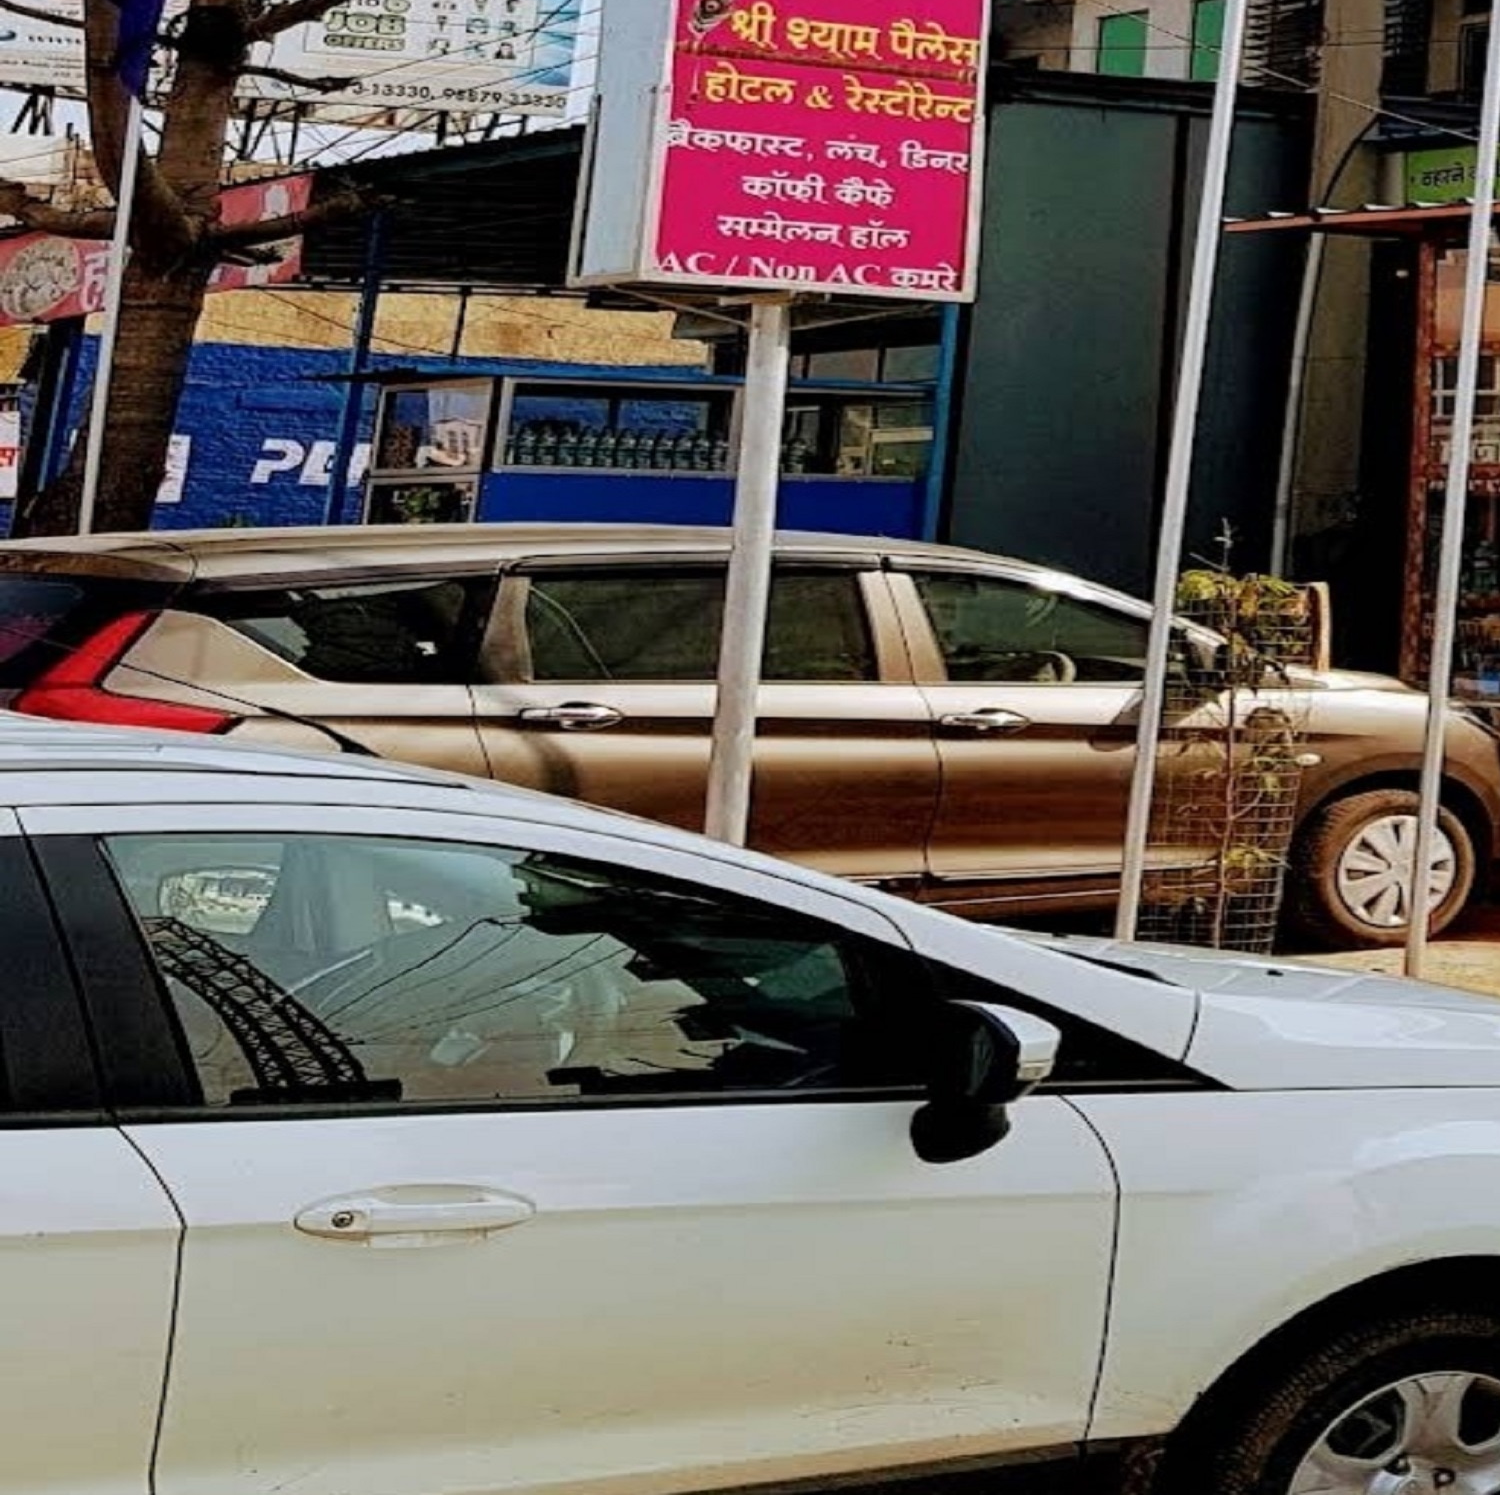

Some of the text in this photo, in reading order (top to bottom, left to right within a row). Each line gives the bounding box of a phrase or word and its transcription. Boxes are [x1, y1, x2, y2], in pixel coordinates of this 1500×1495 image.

[322, 9, 406, 36] JOB
[731, 0, 981, 66] श्री श्याम पैलेस
[703, 60, 976, 126] होटल & रेस्टोरेन्ट
[899, 138, 970, 176] डिनर
[740, 168, 829, 206] कॉफी
[716, 210, 912, 249] सम्मेलन हॉल
[658, 250, 715, 277] AC
[749, 256, 816, 283] Non
[825, 264, 882, 287] AC
[888, 262, 959, 293] कमरे
